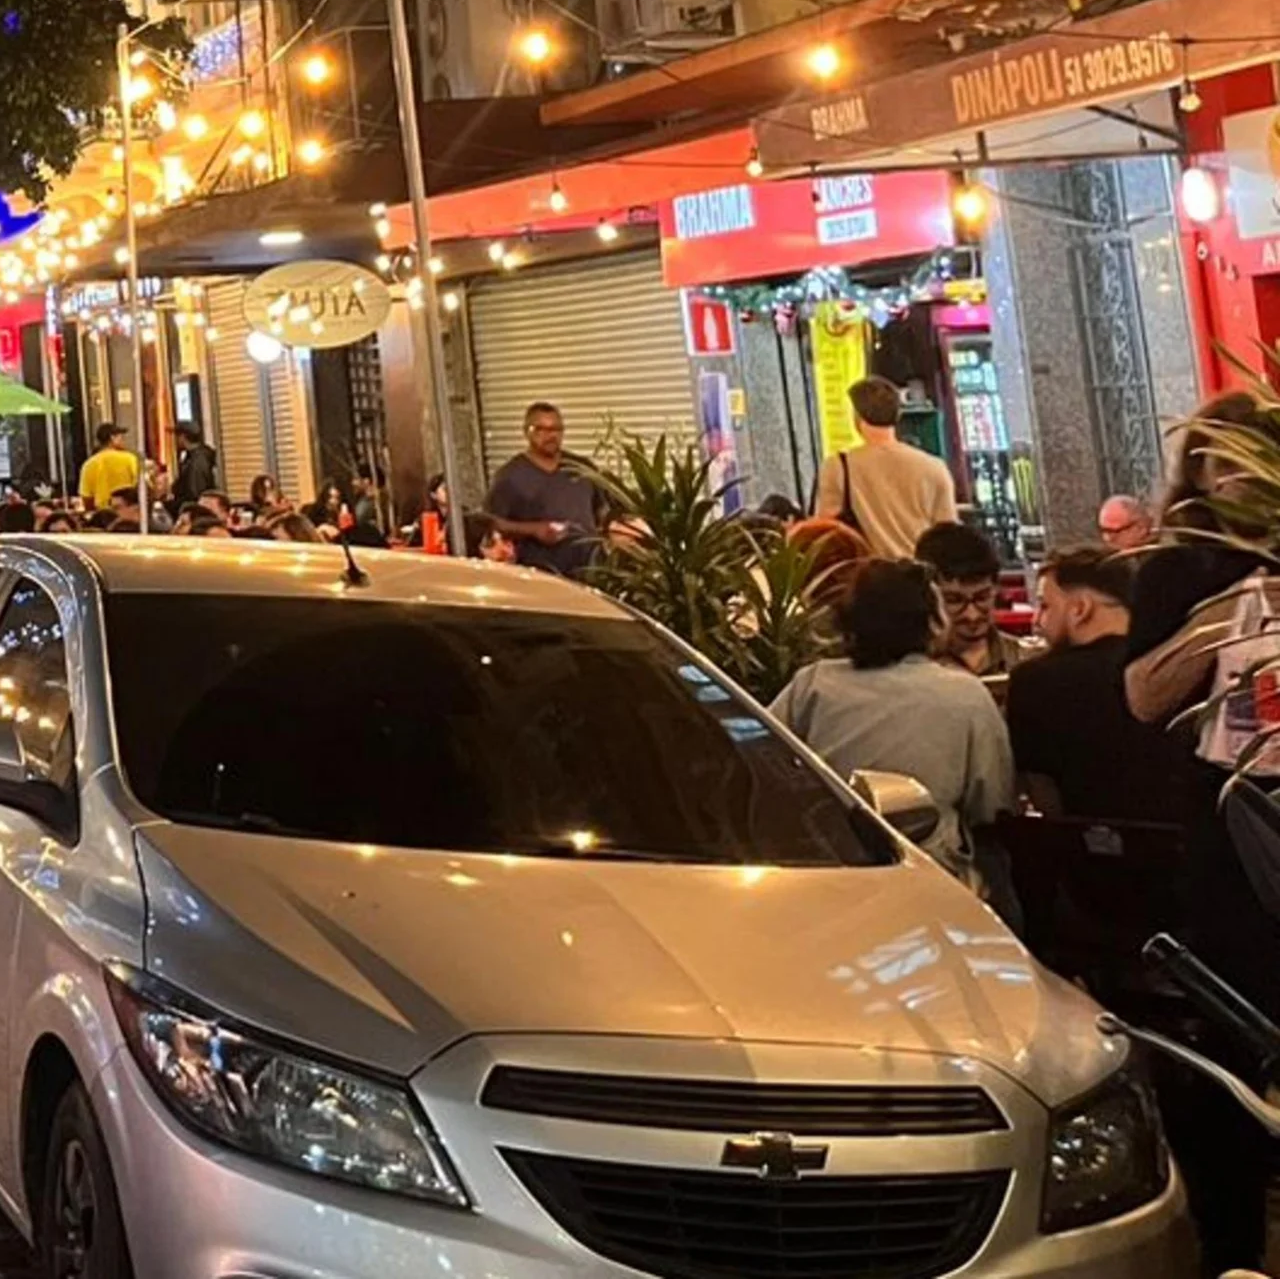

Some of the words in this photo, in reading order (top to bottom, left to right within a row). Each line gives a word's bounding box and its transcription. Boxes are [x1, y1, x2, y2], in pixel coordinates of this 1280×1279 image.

[951, 48, 1063, 122] DINÁPOLI
[1064, 55, 1085, 96] 51
[673, 183, 755, 239] BRAHMA
